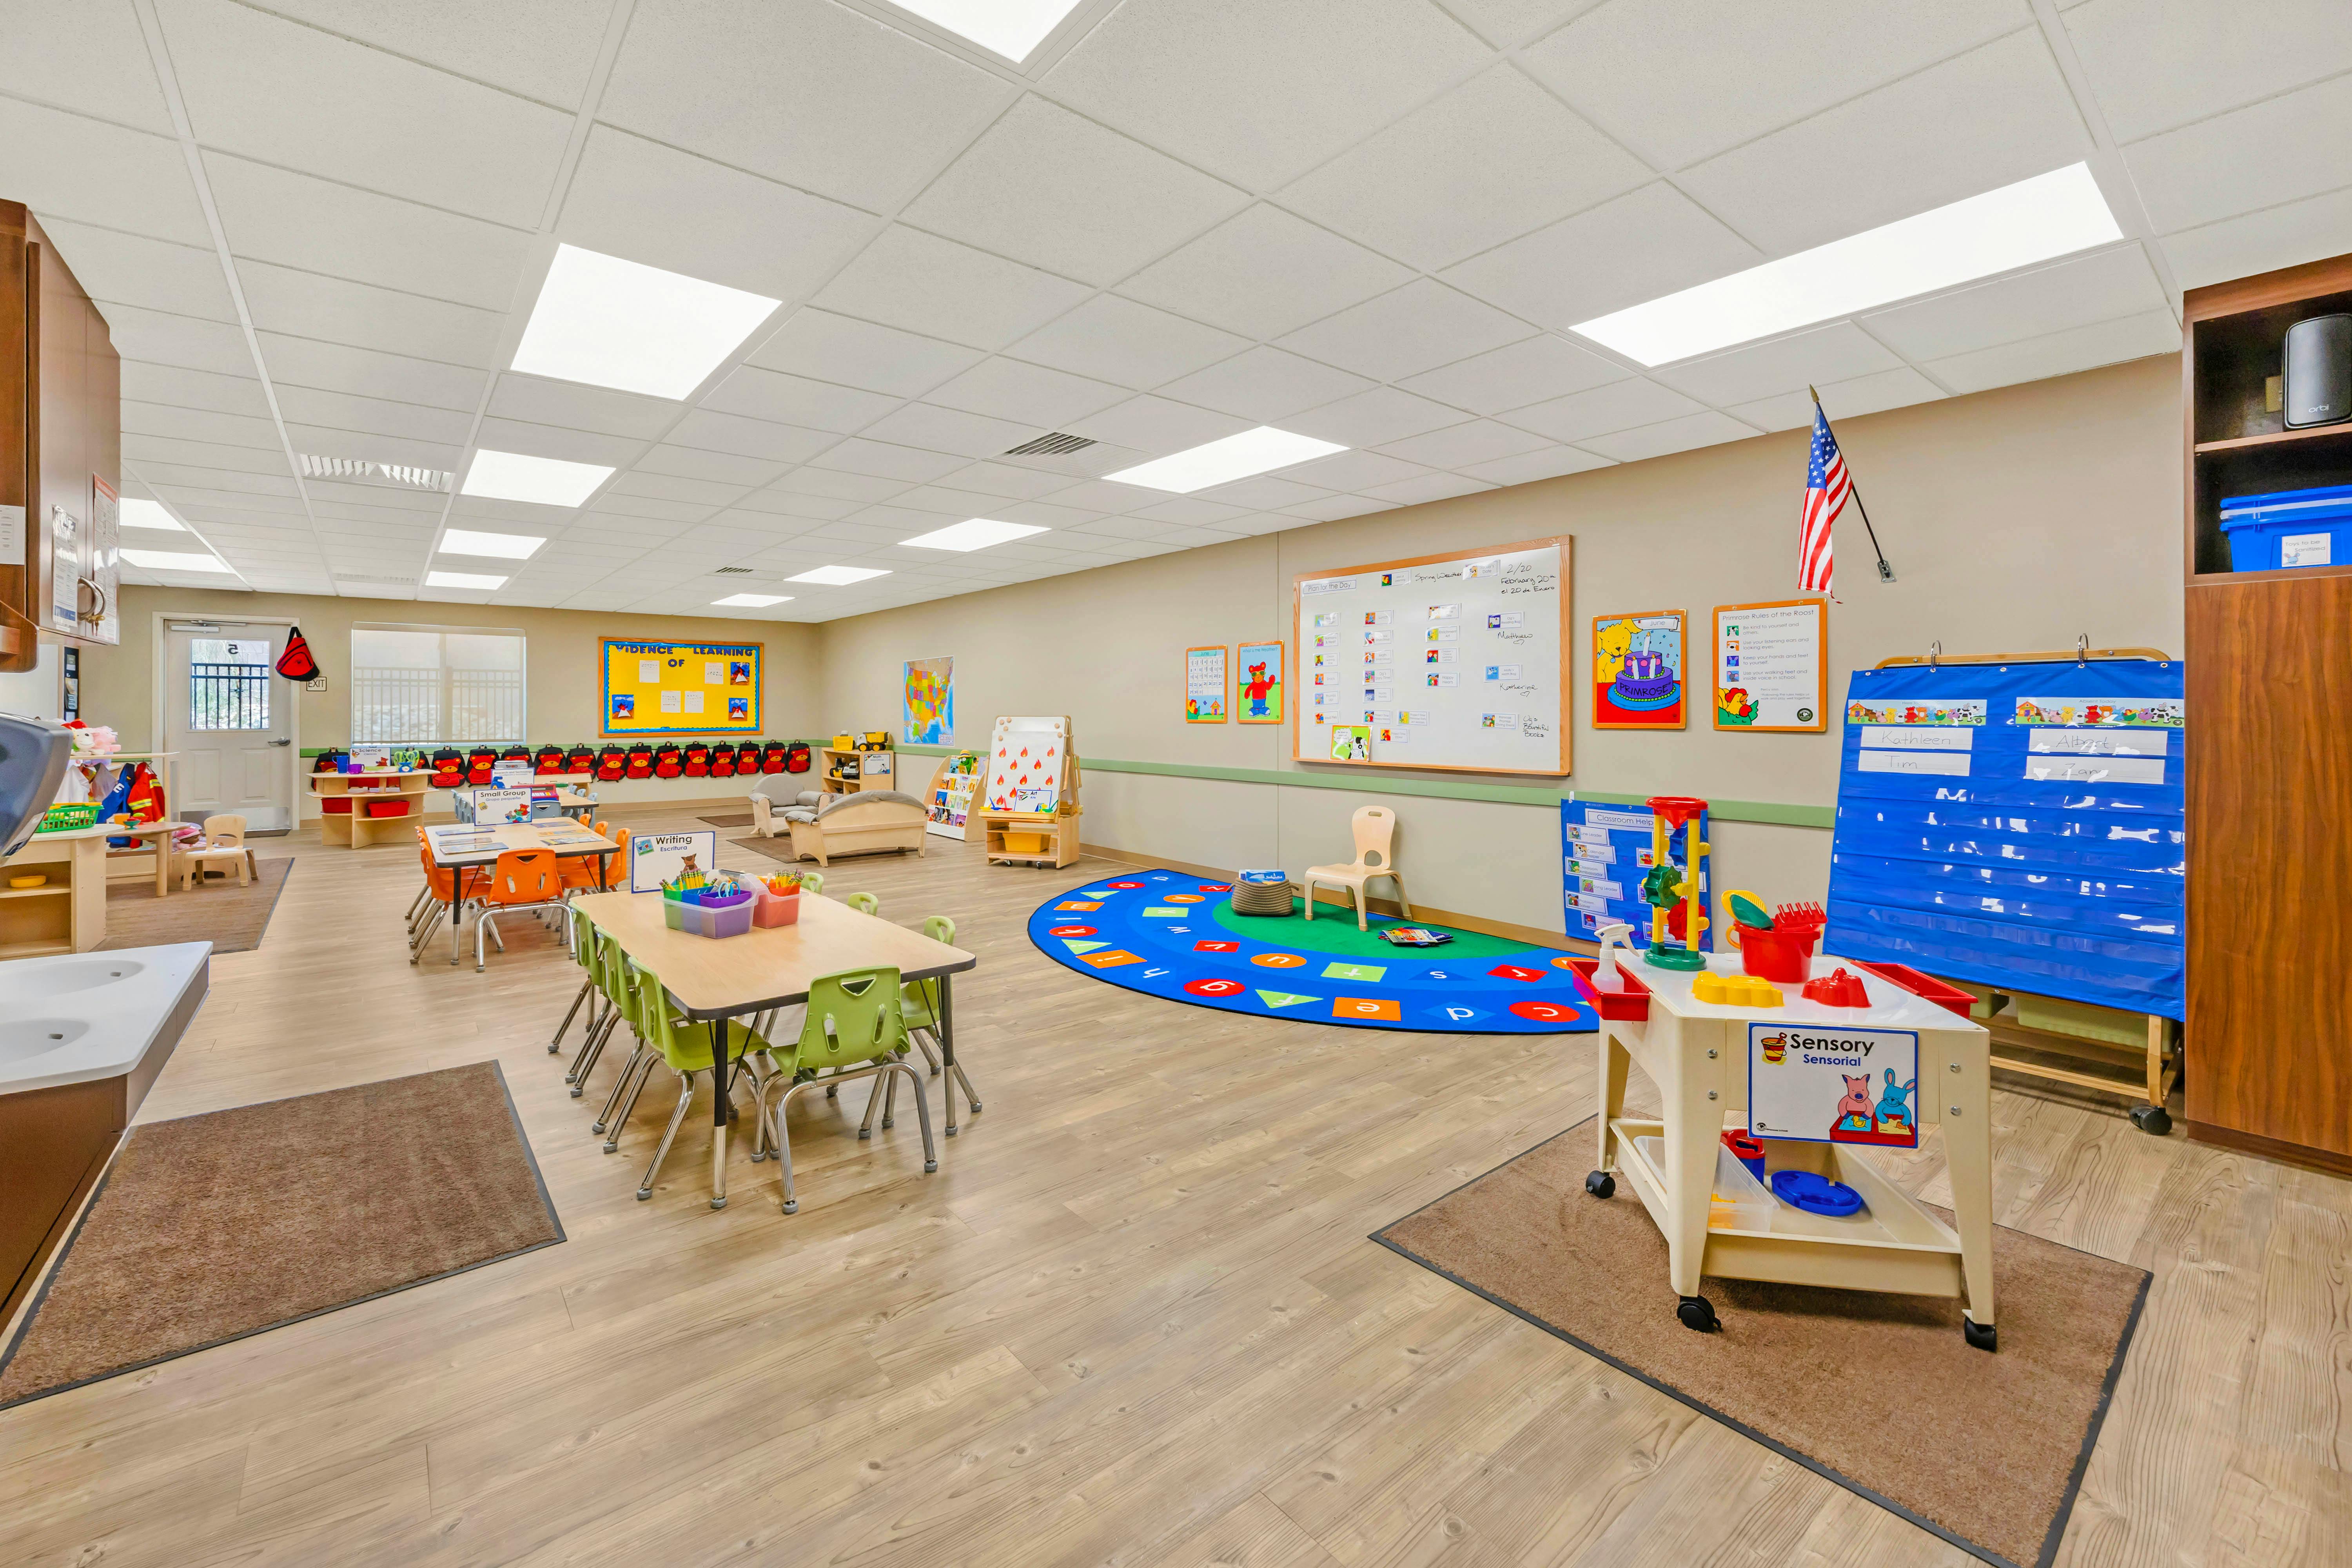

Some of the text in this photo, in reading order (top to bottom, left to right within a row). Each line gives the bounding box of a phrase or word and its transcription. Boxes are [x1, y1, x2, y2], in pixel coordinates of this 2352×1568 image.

[2308, 404, 2329, 413] orbi
[1507, 562, 1532, 575] 2/20
[1415, 573, 1436, 583] Spring
[1501, 576, 1536, 586] February
[1497, 631, 1533, 639] Matthew
[693, 647, 753, 657] LEARNING
[668, 659, 685, 667] OF
[1620, 682, 1668, 697] PRIMROSE
[1882, 730, 1951, 745] Kathleen
[2056, 734, 2109, 749] Albert
[1884, 755, 1918, 769] Tim
[1596, 814, 1634, 824] Classroom
[655, 835, 693, 845] Writing
[1790, 1033, 1875, 1056] Sensory
[1803, 1054, 1861, 1067] Sensorial
